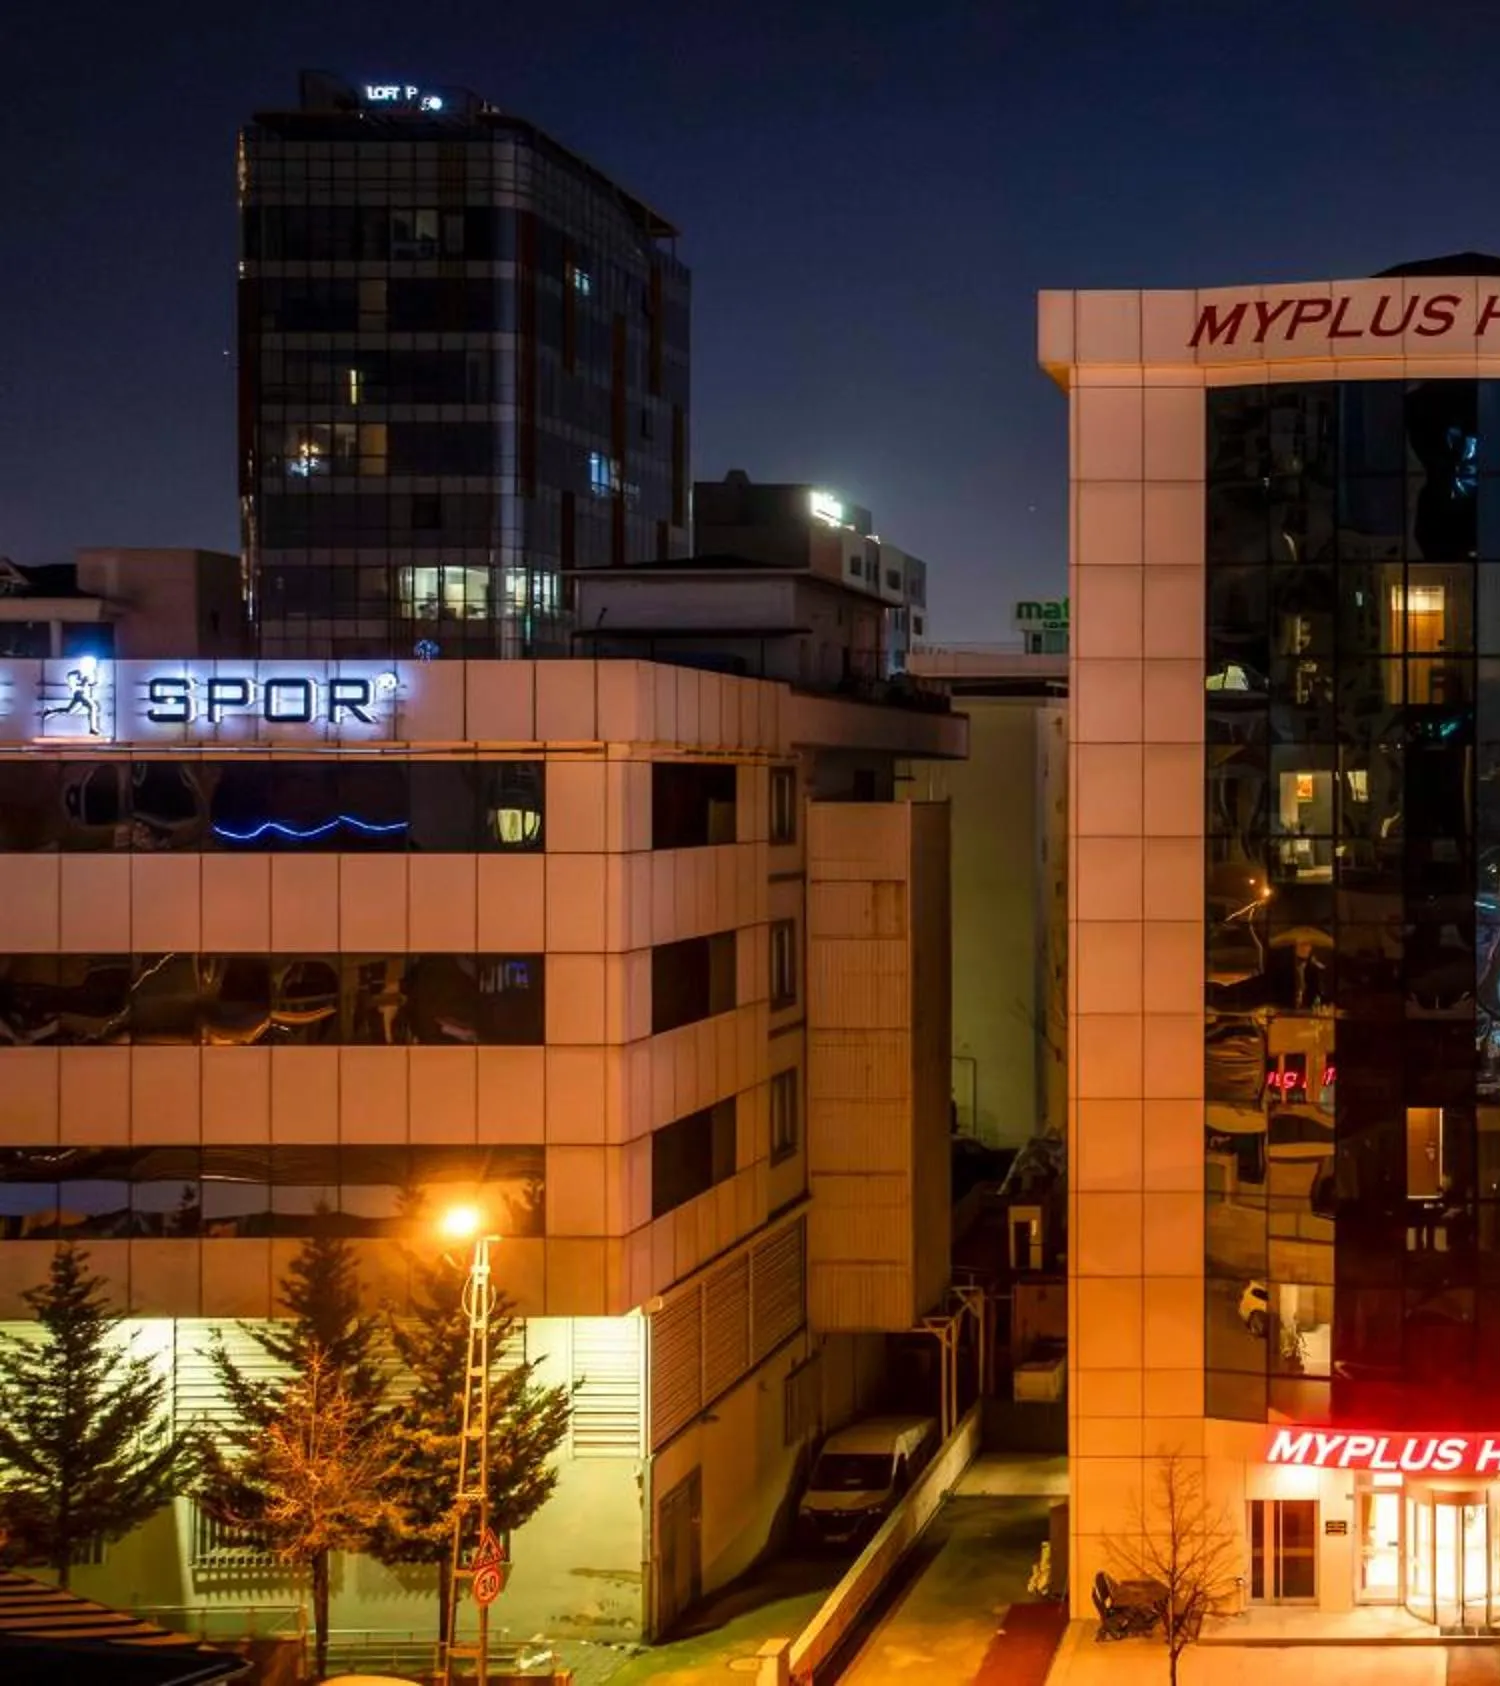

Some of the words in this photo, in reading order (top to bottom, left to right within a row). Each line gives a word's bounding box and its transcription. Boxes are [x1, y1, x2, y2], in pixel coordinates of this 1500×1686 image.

[366, 85, 400, 101] LOFT
[1187, 295, 1462, 347] MYPLUS
[147, 677, 377, 723] SPOR
[1267, 1430, 1467, 1471] MYPLUS
